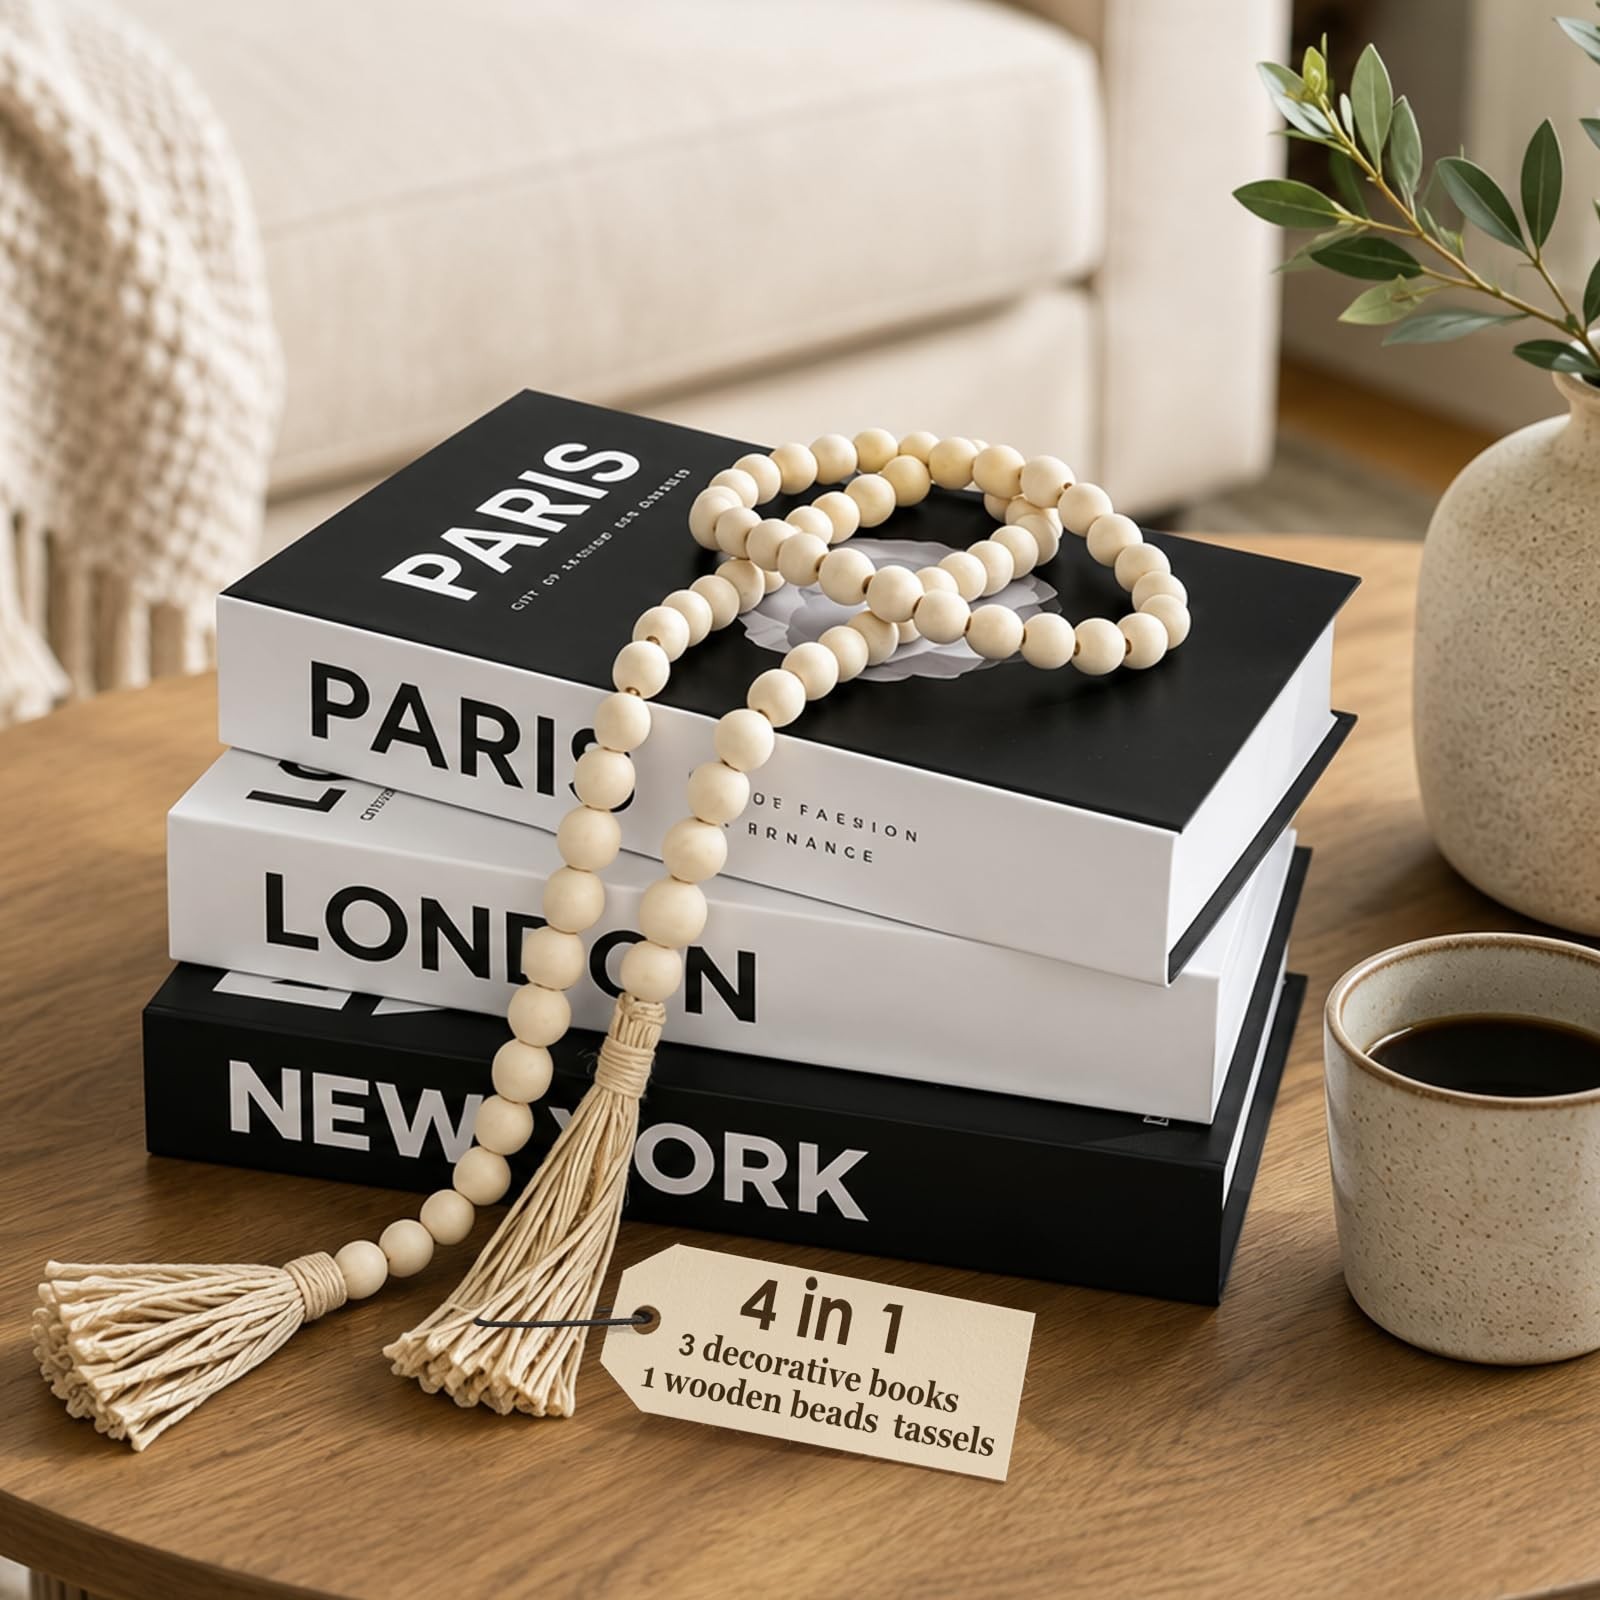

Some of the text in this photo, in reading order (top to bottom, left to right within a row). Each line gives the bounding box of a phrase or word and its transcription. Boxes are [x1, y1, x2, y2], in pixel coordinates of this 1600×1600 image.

[382, 443, 640, 601] PARIS
[229, 1060, 869, 1222] NEW ORK
[739, 1276, 904, 1355] 4 in 1
[641, 1367, 995, 1457] 1 wooden beads tassels
[679, 1333, 959, 1413] 3 decorative books
